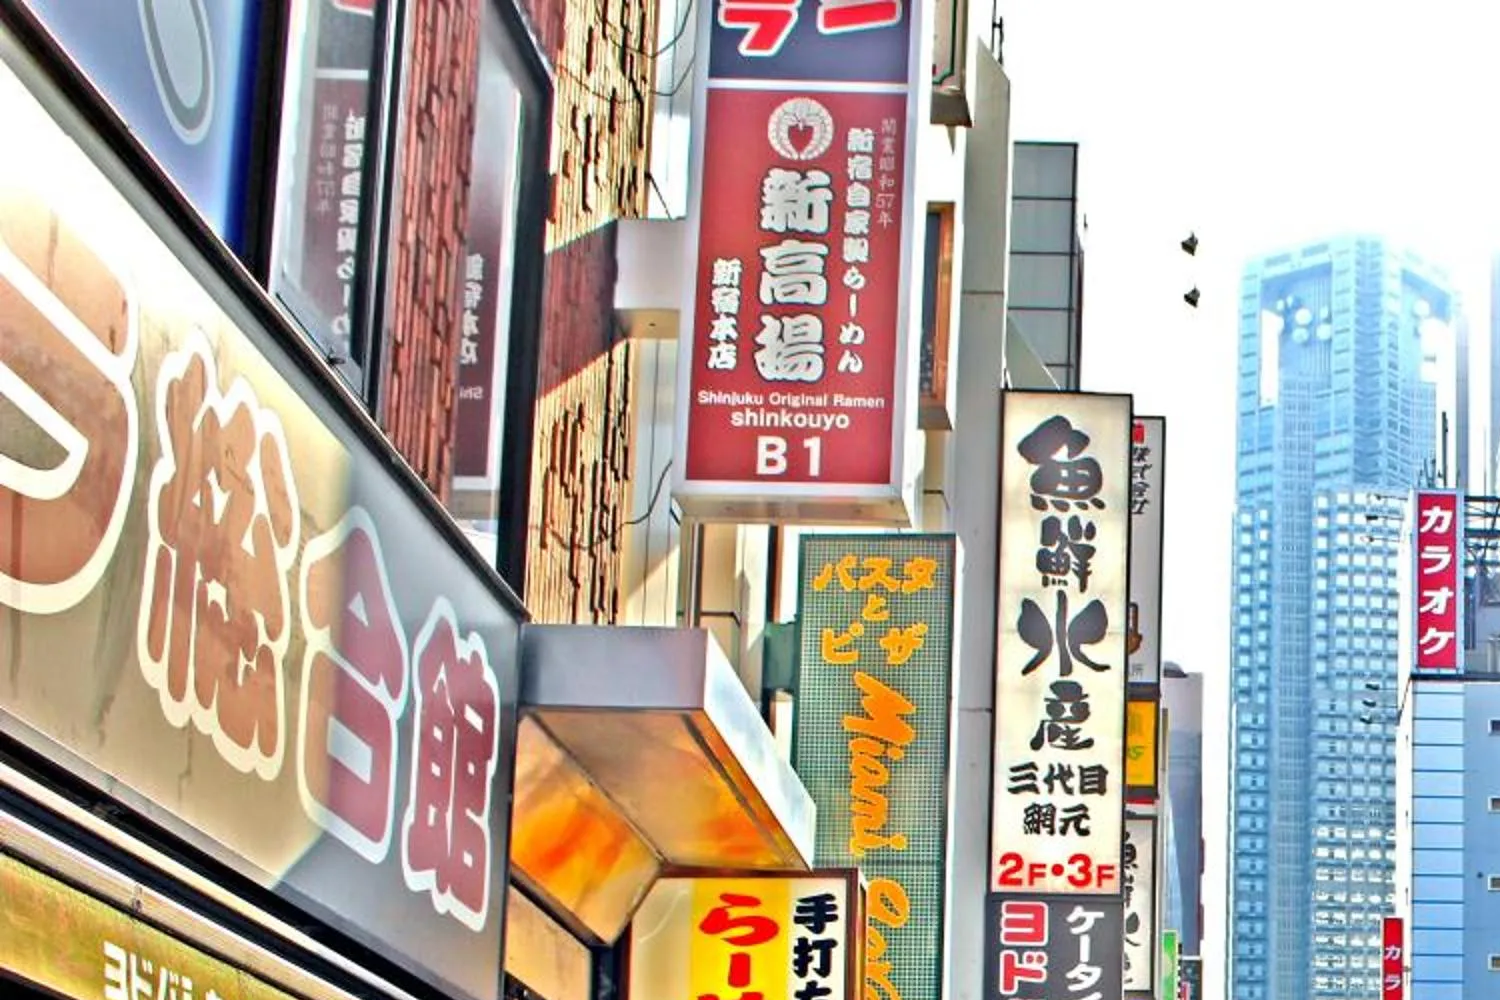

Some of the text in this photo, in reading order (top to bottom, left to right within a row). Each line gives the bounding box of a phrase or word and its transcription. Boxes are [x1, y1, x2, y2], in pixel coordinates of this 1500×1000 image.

[755, 167, 834, 382] 新高揚
[698, 390, 884, 408] Shinjuku Original Ramen
[731, 408, 849, 431] shinkouyo
[813, 555, 937, 592] パスタ
[1017, 414, 1111, 752] 魚鮮水産
[1419, 505, 1456, 656] カラオケ
[863, 594, 888, 620] と
[822, 622, 929, 664] ピザ
[842, 671, 917, 857] Miami
[1008, 763, 1109, 797] 三代目
[1022, 802, 1092, 837] 網元
